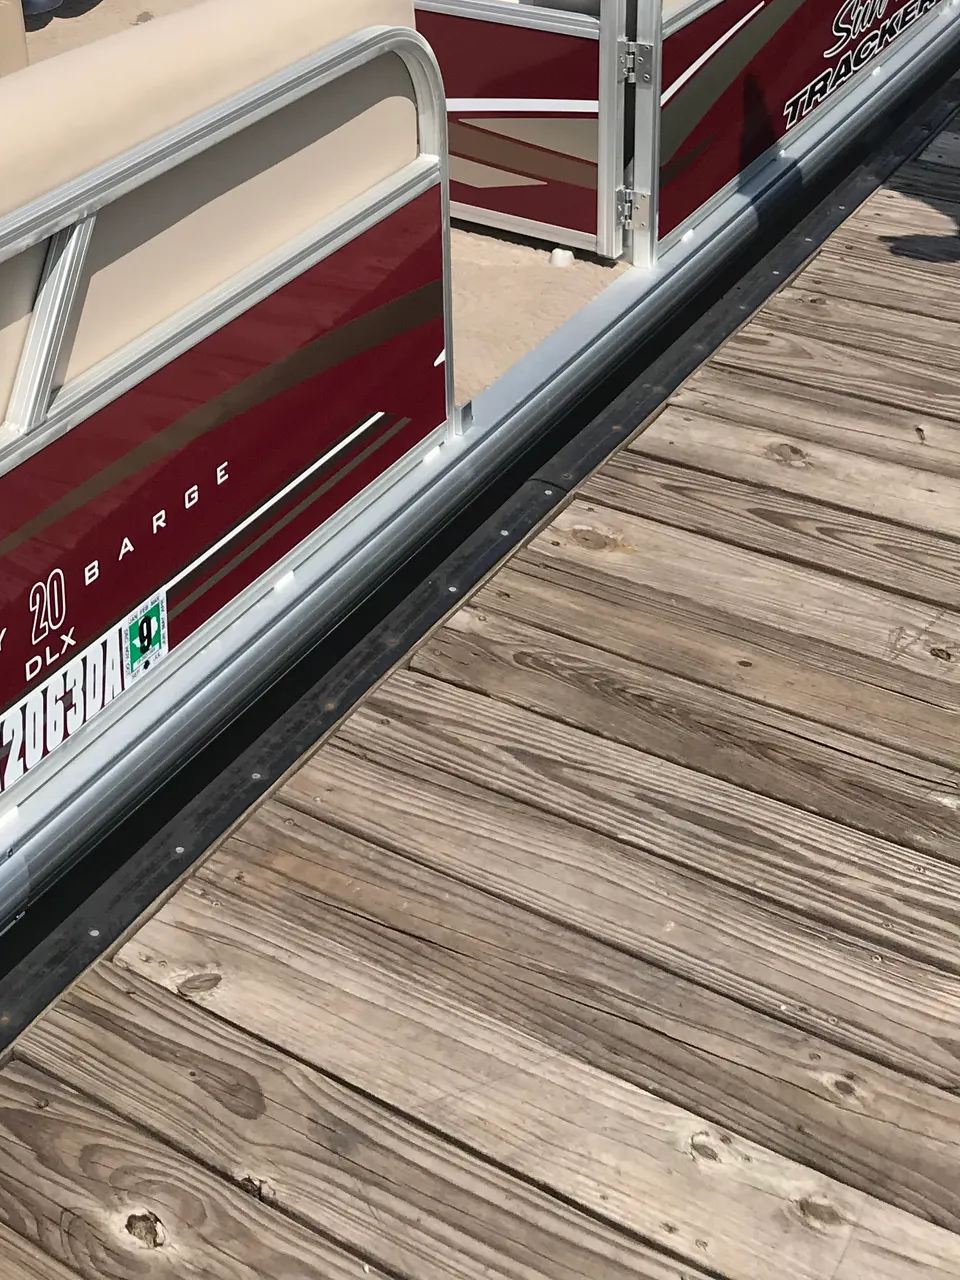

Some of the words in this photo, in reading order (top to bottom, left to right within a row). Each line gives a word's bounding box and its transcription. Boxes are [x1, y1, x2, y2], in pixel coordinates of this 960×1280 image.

[29, 567, 67, 646] 20
[84, 461, 229, 587] BARGE
[25, 627, 77, 682] DLX
[138, 615, 152, 655] 9
